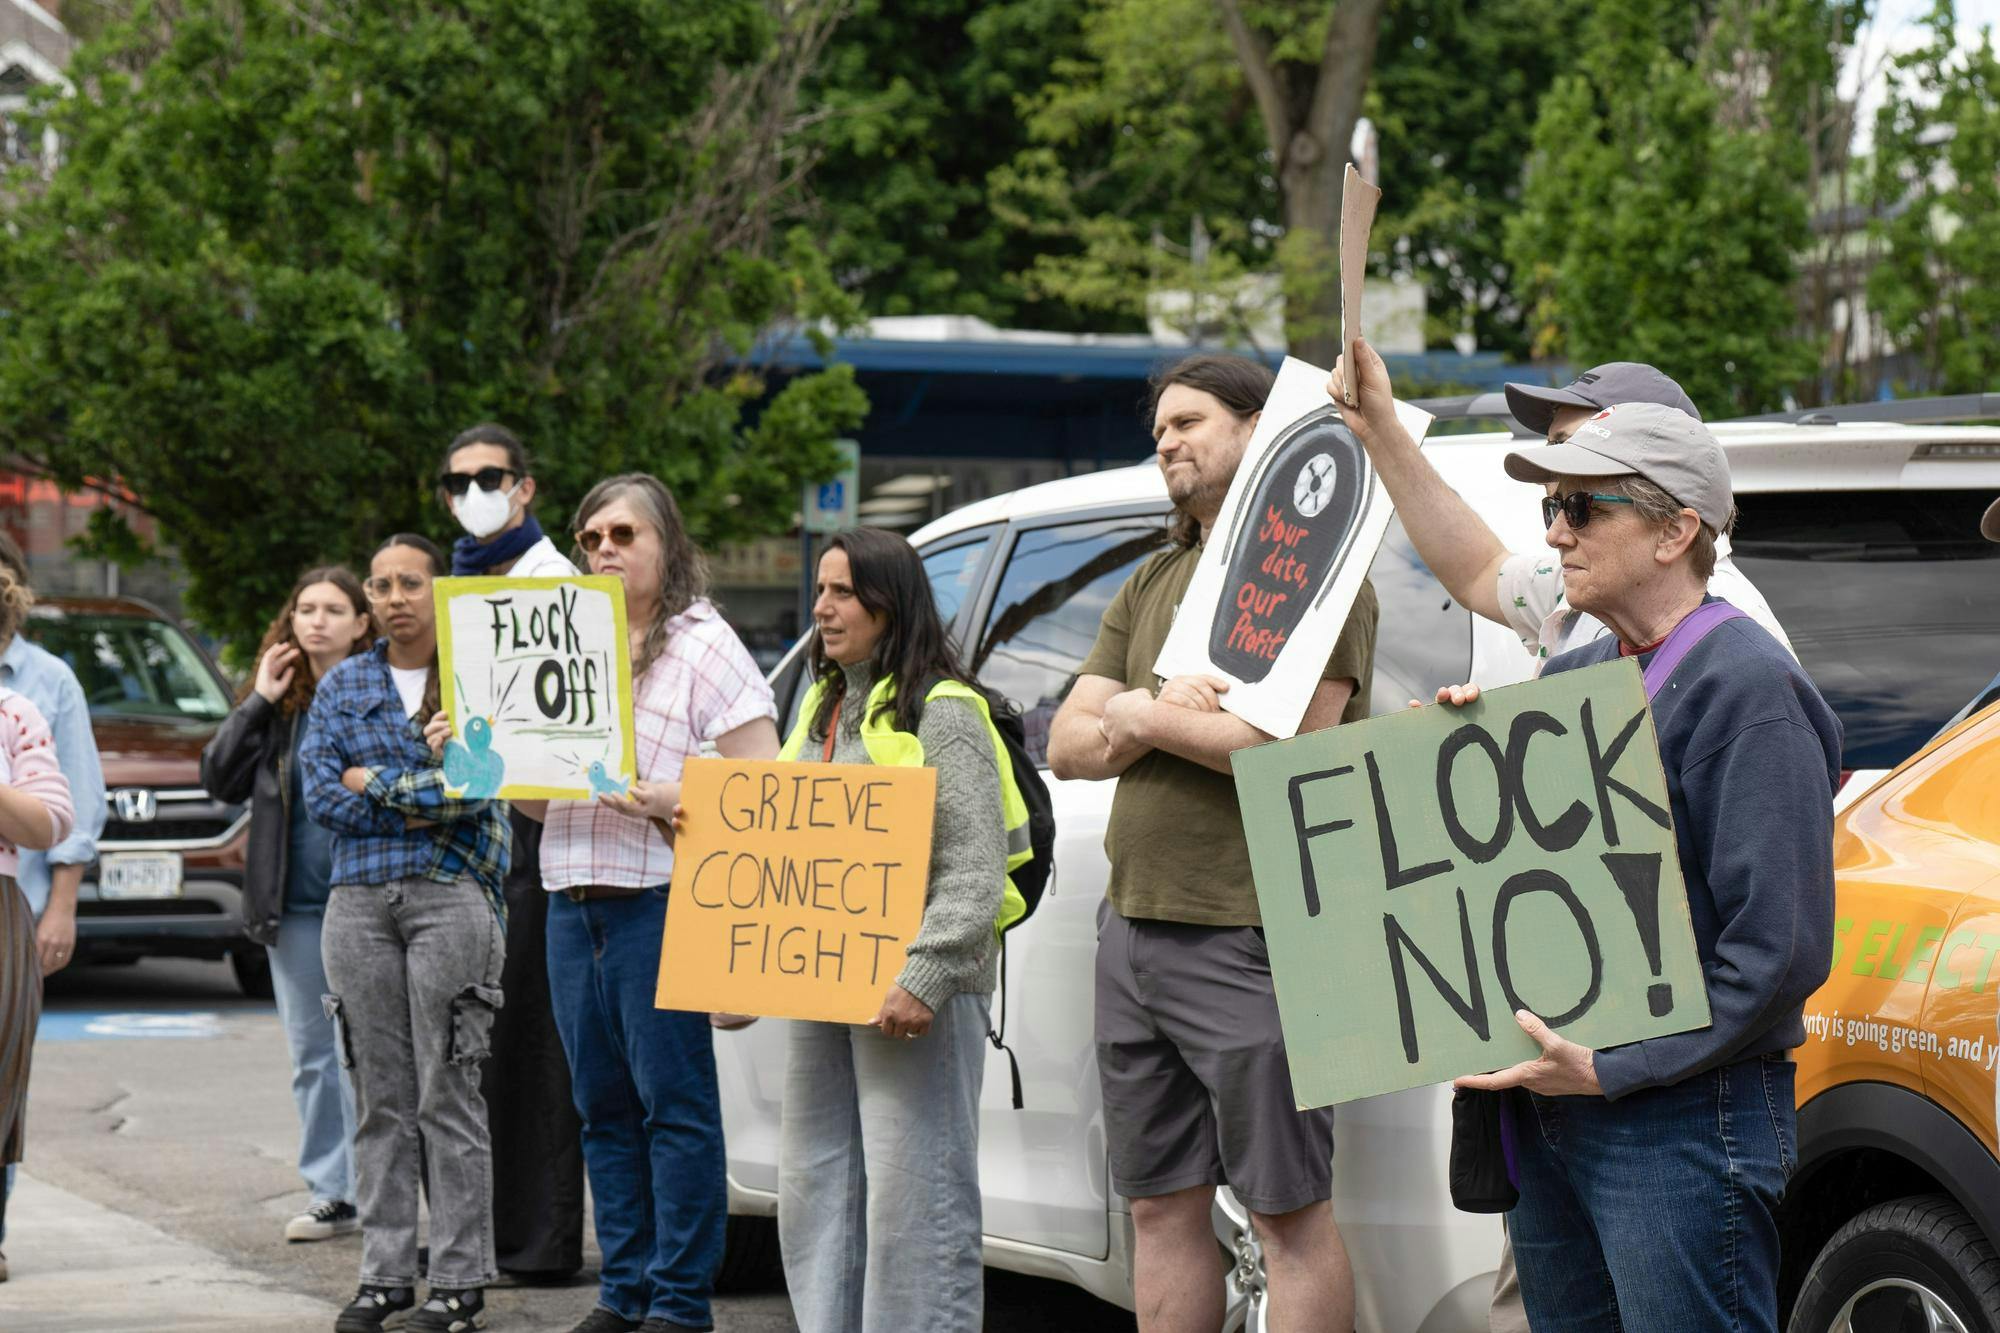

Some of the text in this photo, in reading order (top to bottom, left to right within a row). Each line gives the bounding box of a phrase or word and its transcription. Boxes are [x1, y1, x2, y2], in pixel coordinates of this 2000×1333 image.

[1259, 504, 1309, 548] Your
[1260, 543, 1309, 590] data,
[484, 586, 581, 657] FLOCK
[1236, 582, 1287, 618] Our
[1226, 610, 1286, 660] Profit
[719, 772, 893, 833] GRIEVE
[1288, 697, 1672, 917] FLOCK
[691, 850, 902, 918] CONNECT
[729, 922, 899, 986] FIGHT
[1383, 852, 1675, 1064] NO!
[1832, 1010, 1844, 1038] is
[1847, 1014, 1889, 1051] going
[1891, 1026, 1943, 1061] green,
[1947, 1035, 1984, 1063] and
